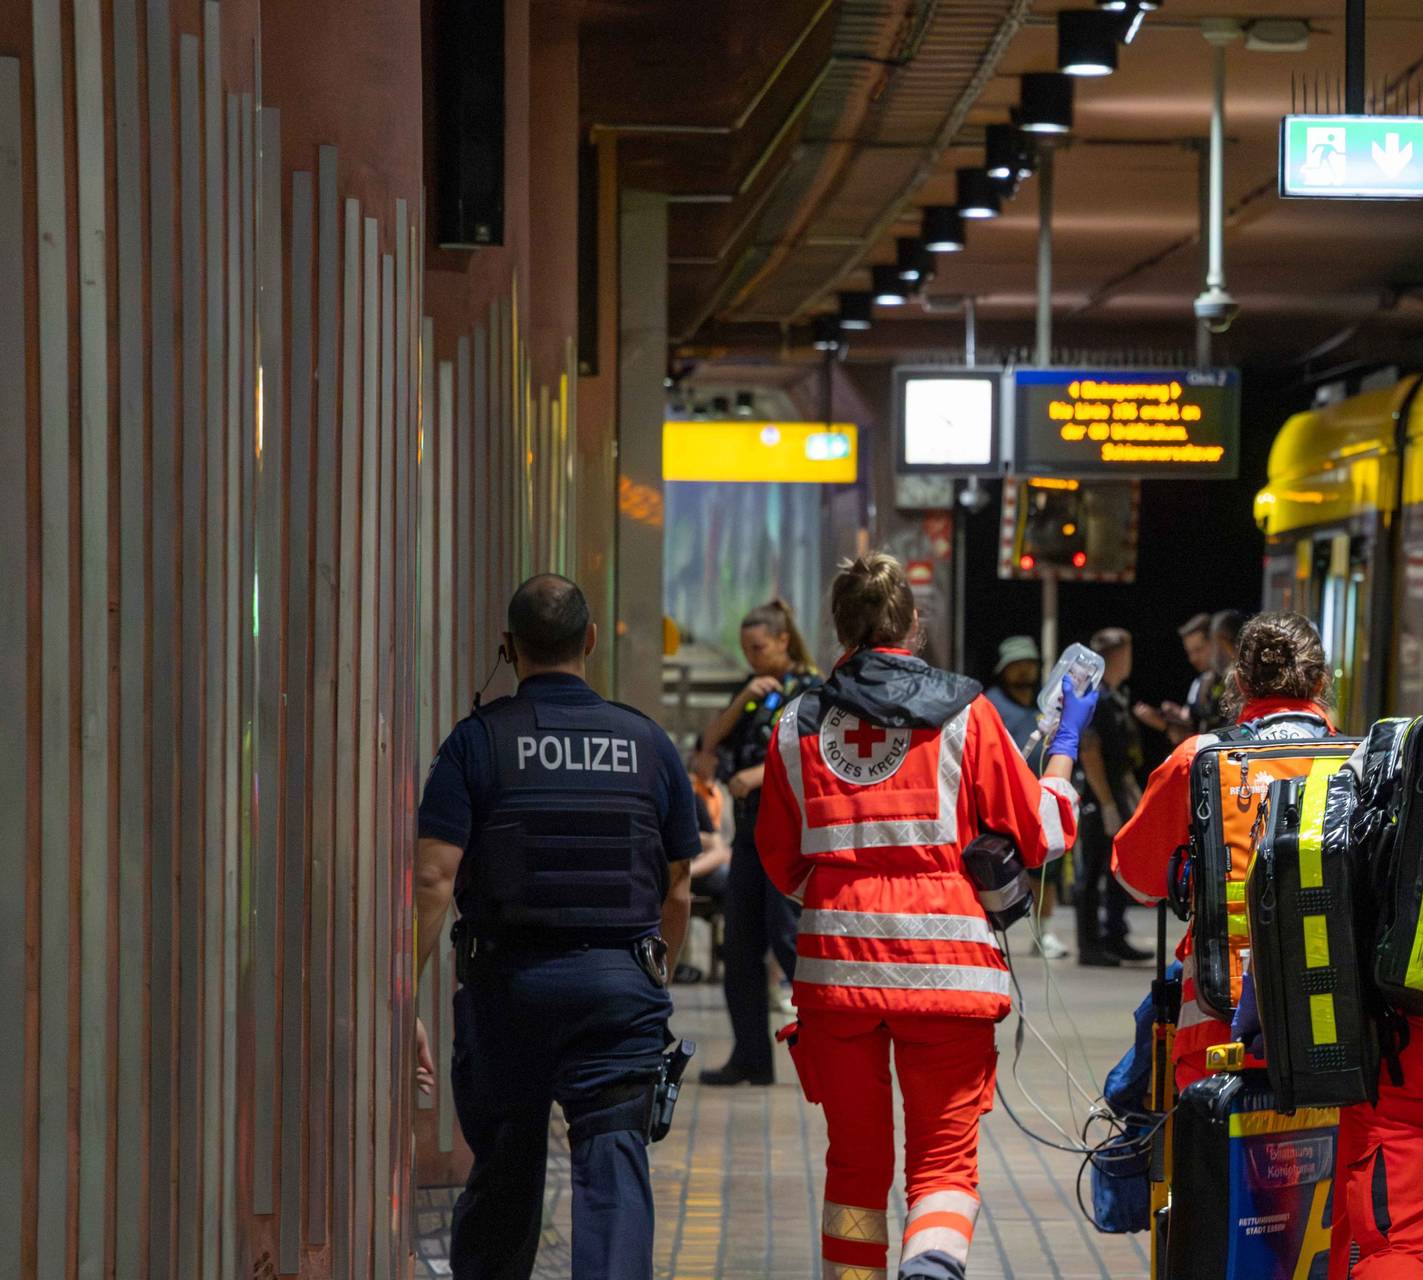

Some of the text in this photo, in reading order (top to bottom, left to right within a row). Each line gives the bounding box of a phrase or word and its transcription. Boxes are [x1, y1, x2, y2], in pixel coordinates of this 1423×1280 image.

[517, 735, 638, 774] POLIZEI
[826, 737, 905, 777] ROTES KREUZ
